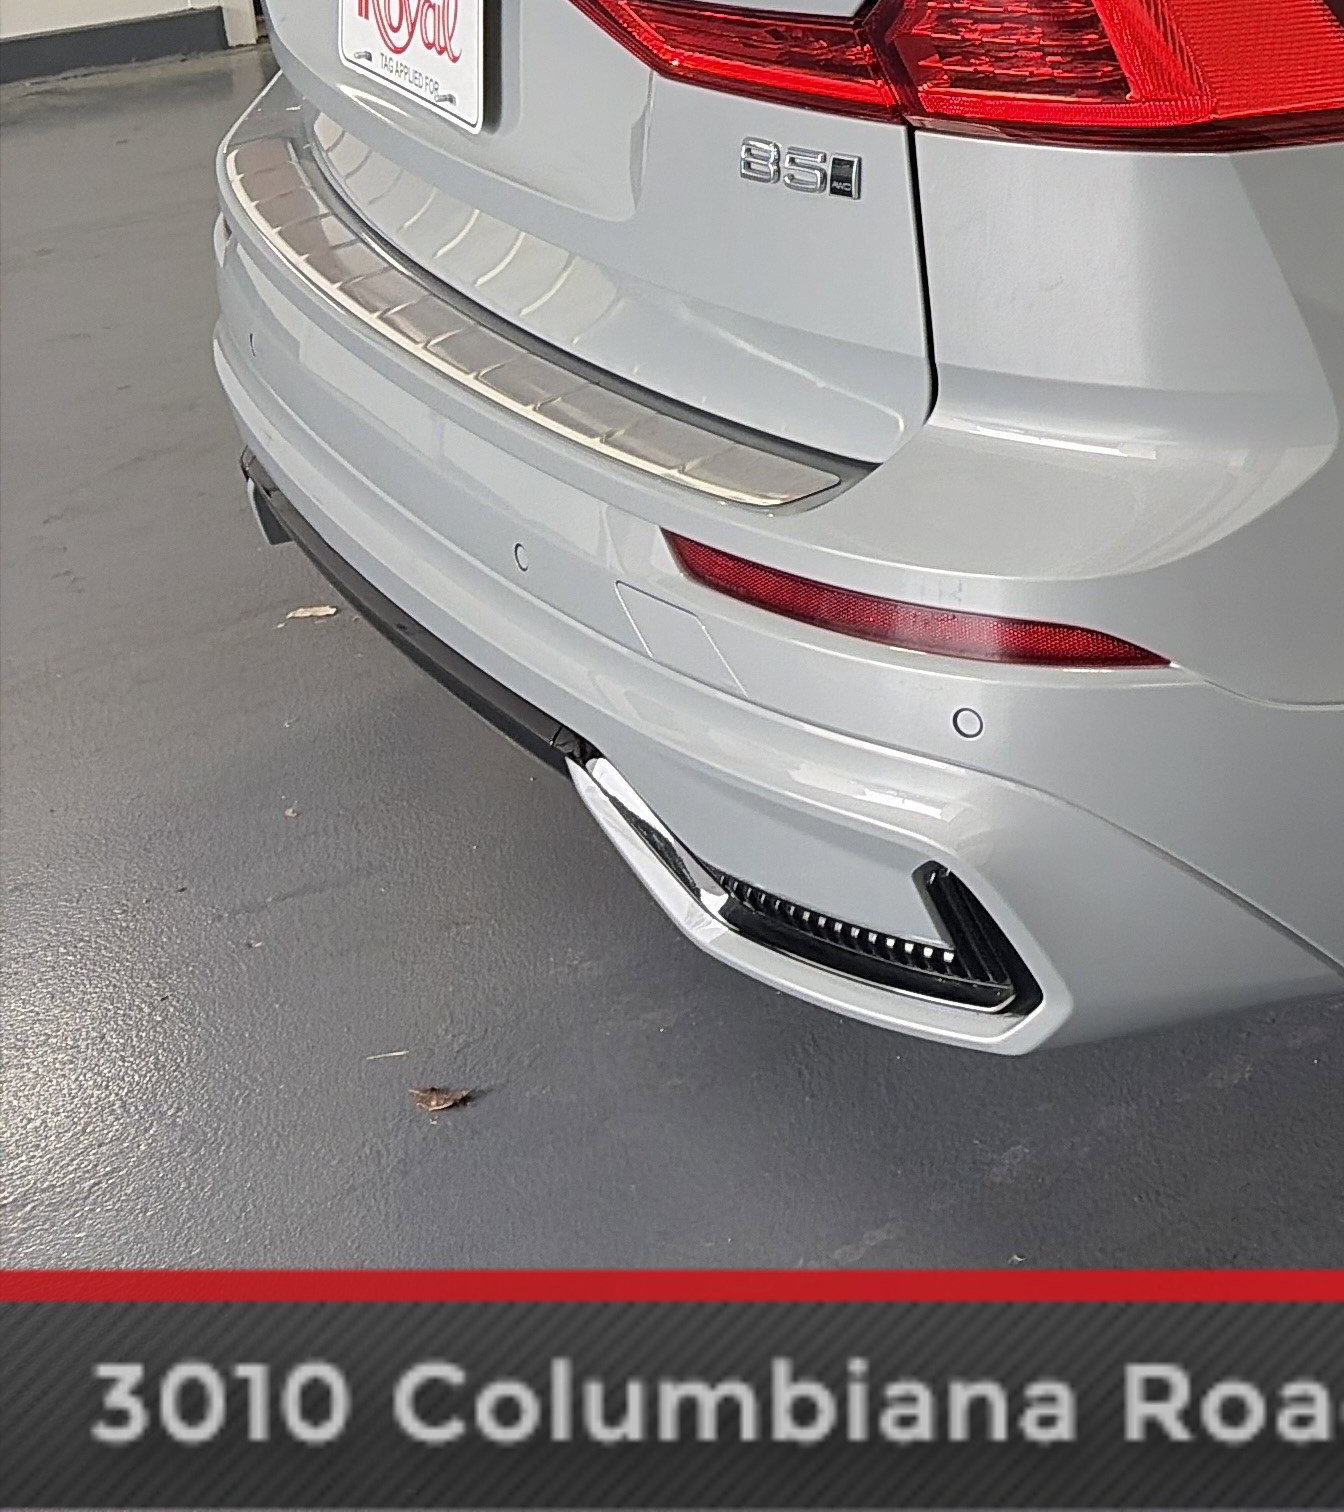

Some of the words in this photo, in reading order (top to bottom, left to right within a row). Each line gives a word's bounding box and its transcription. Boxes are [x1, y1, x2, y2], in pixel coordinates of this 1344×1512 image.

[380, 53, 394, 74] TAG
[394, 59, 424, 89] APPLIED
[425, 75, 440, 97] FOR
